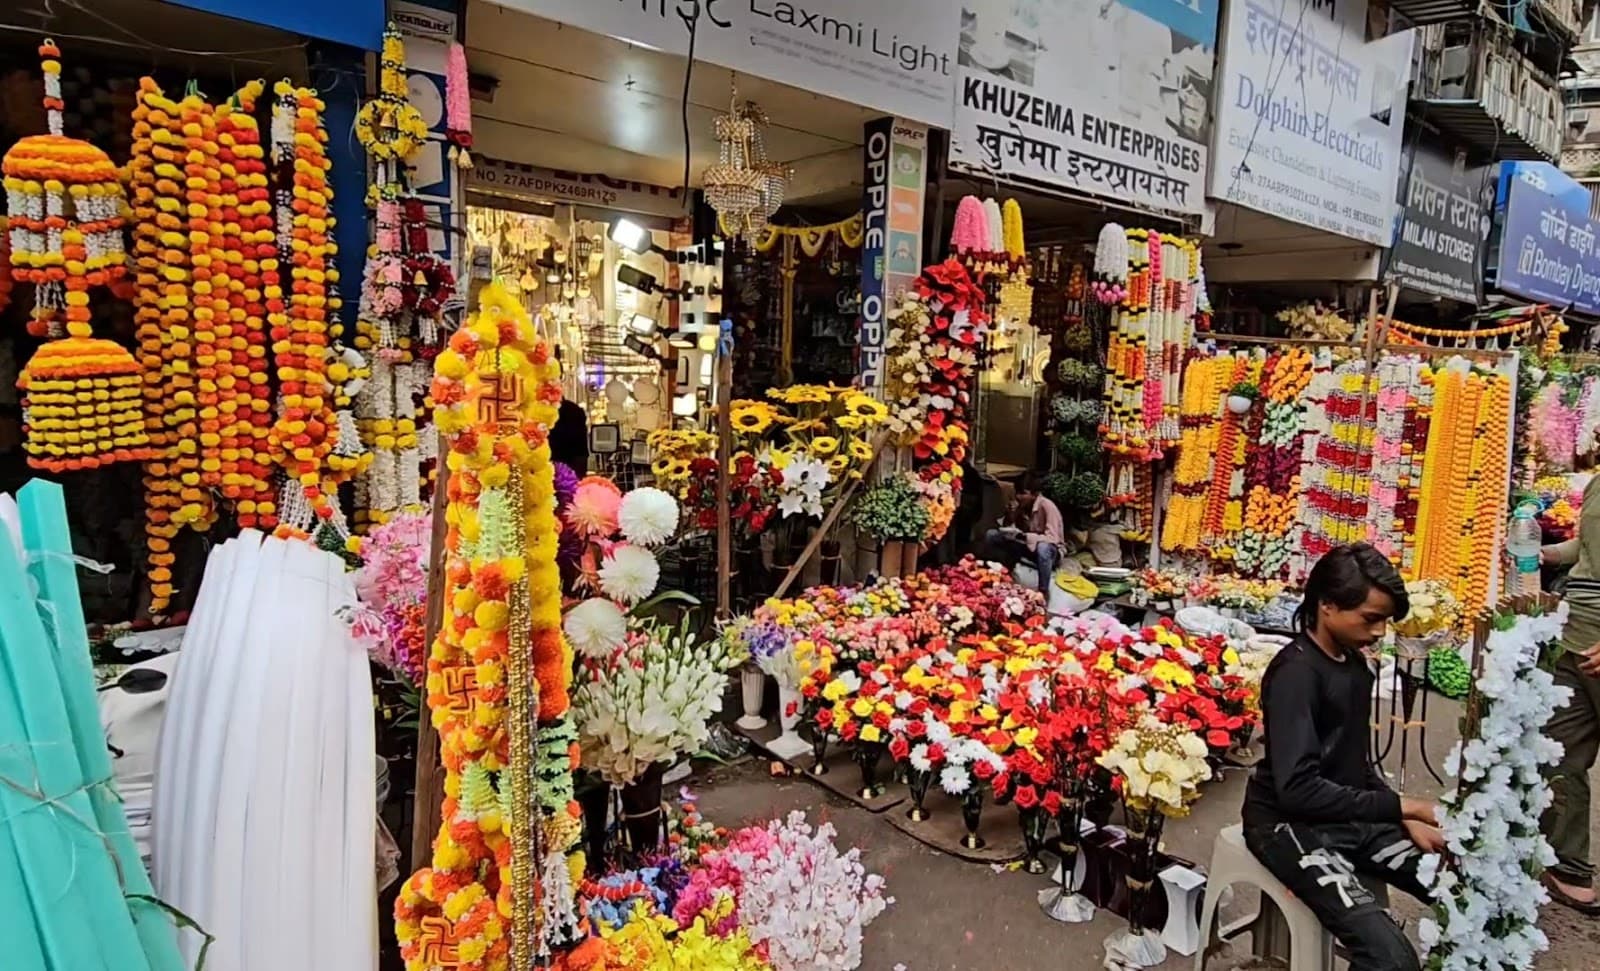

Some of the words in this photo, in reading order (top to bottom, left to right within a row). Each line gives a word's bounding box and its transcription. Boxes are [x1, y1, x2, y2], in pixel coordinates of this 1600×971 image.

[872, 28, 950, 76] Light
[963, 77, 1075, 136] KHUZEMA
[1082, 114, 1200, 173] ENTERPRISES
[976, 121, 1062, 173] खुजेमा
[1236, 73, 1306, 137] Dolphin
[1312, 112, 1383, 170] Electricals
[866, 131, 887, 249] OPPLE
[1403, 220, 1436, 251] MILAN
[1437, 234, 1475, 264] STORES
[1533, 248, 1573, 293] Bombay
